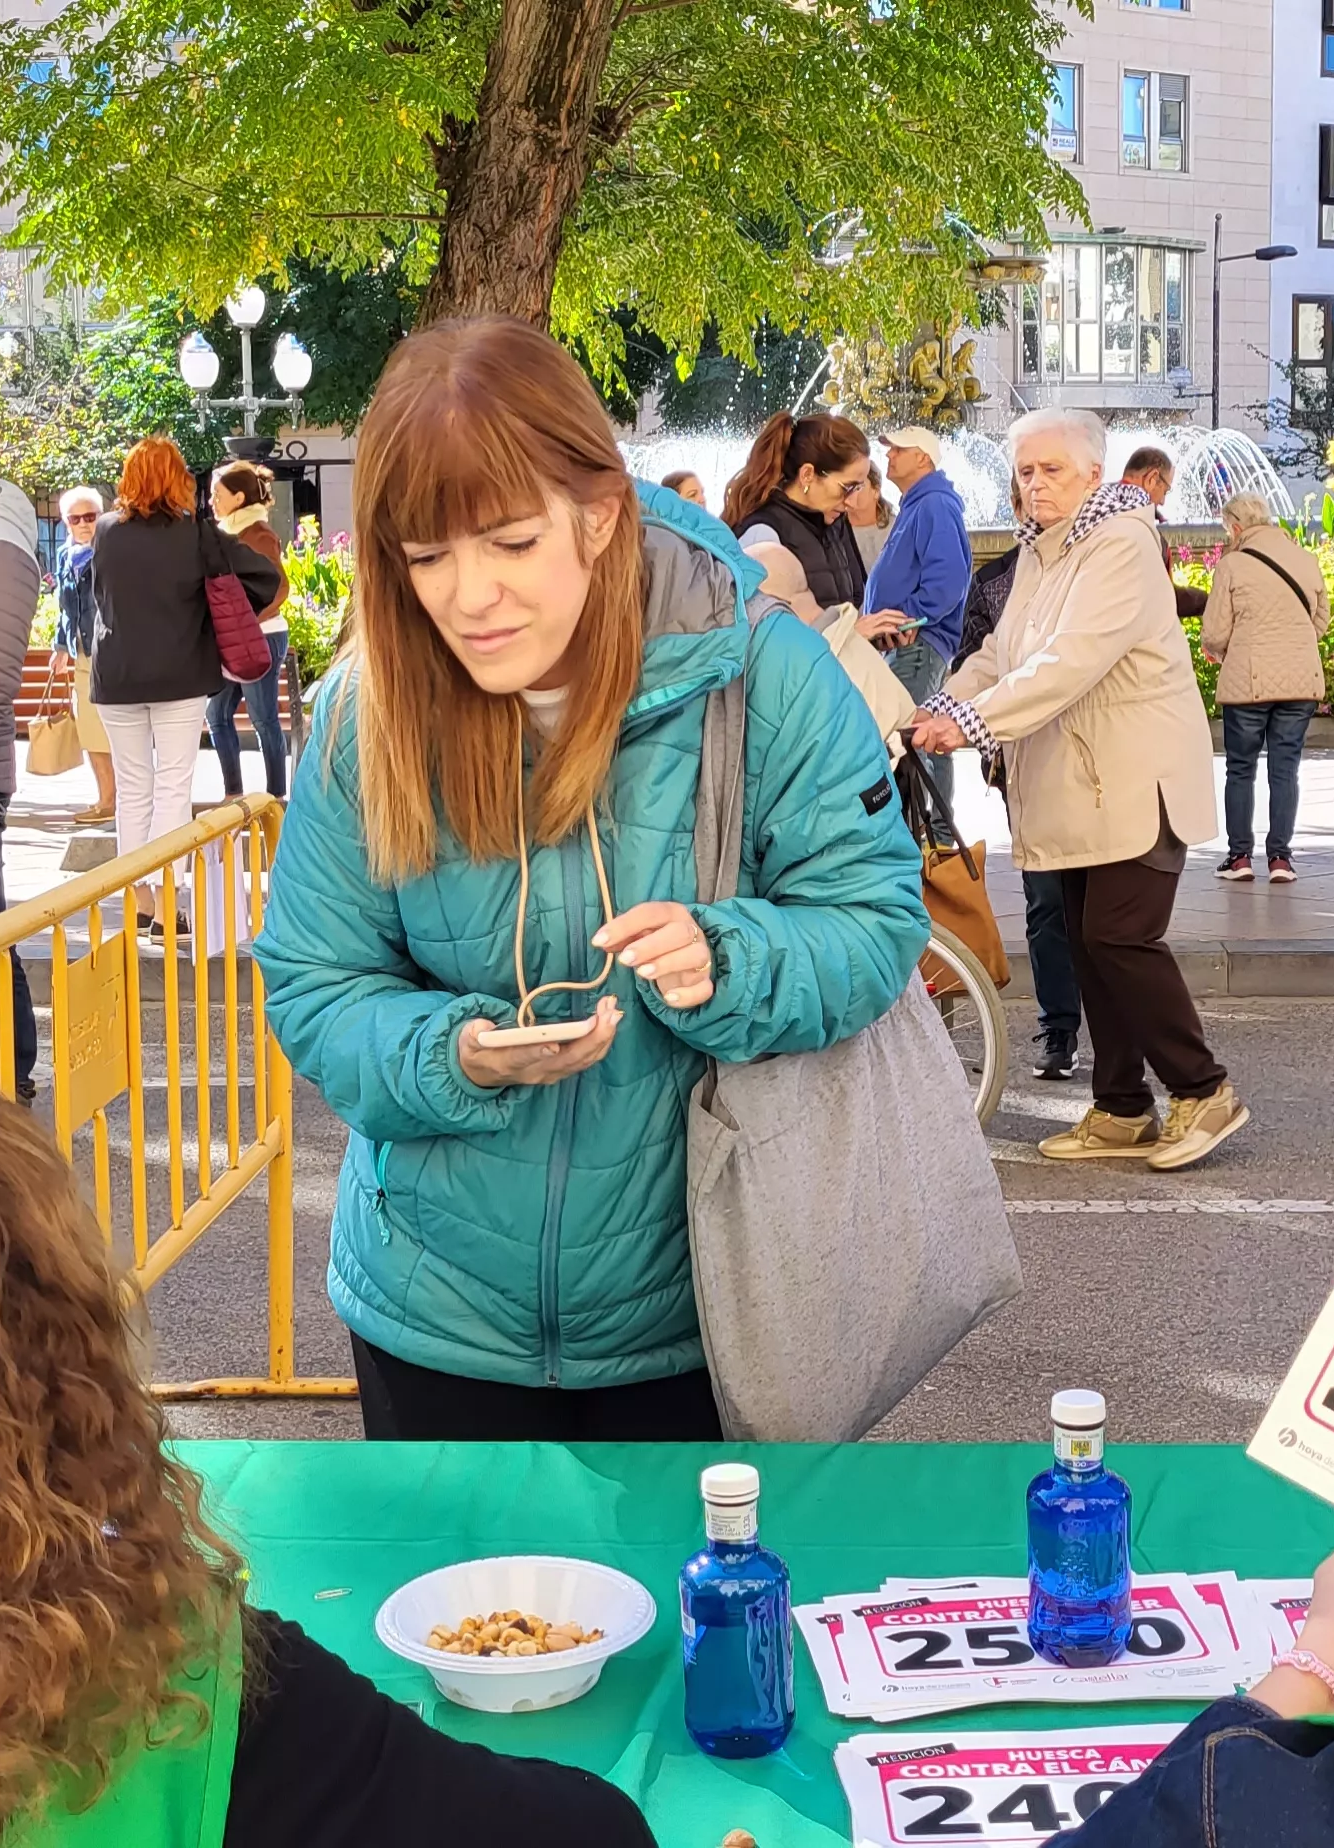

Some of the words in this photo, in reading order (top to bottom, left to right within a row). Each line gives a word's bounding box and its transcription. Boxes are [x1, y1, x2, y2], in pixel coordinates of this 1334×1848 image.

[1298, 1440, 1323, 1462] hoya
[873, 1598, 923, 1614] EDICIÓN
[977, 1597, 1029, 1610] HUES
[883, 1609, 1004, 1625] CONTRA
[877, 1756, 889, 1765] IX
[890, 1745, 946, 1763] EDICIÓN
[1007, 1748, 1102, 1763] HUESCA
[899, 1762, 1033, 1779] CONTRA
[1045, 1761, 1080, 1774] EL
[1089, 1755, 1153, 1773] CÁN
